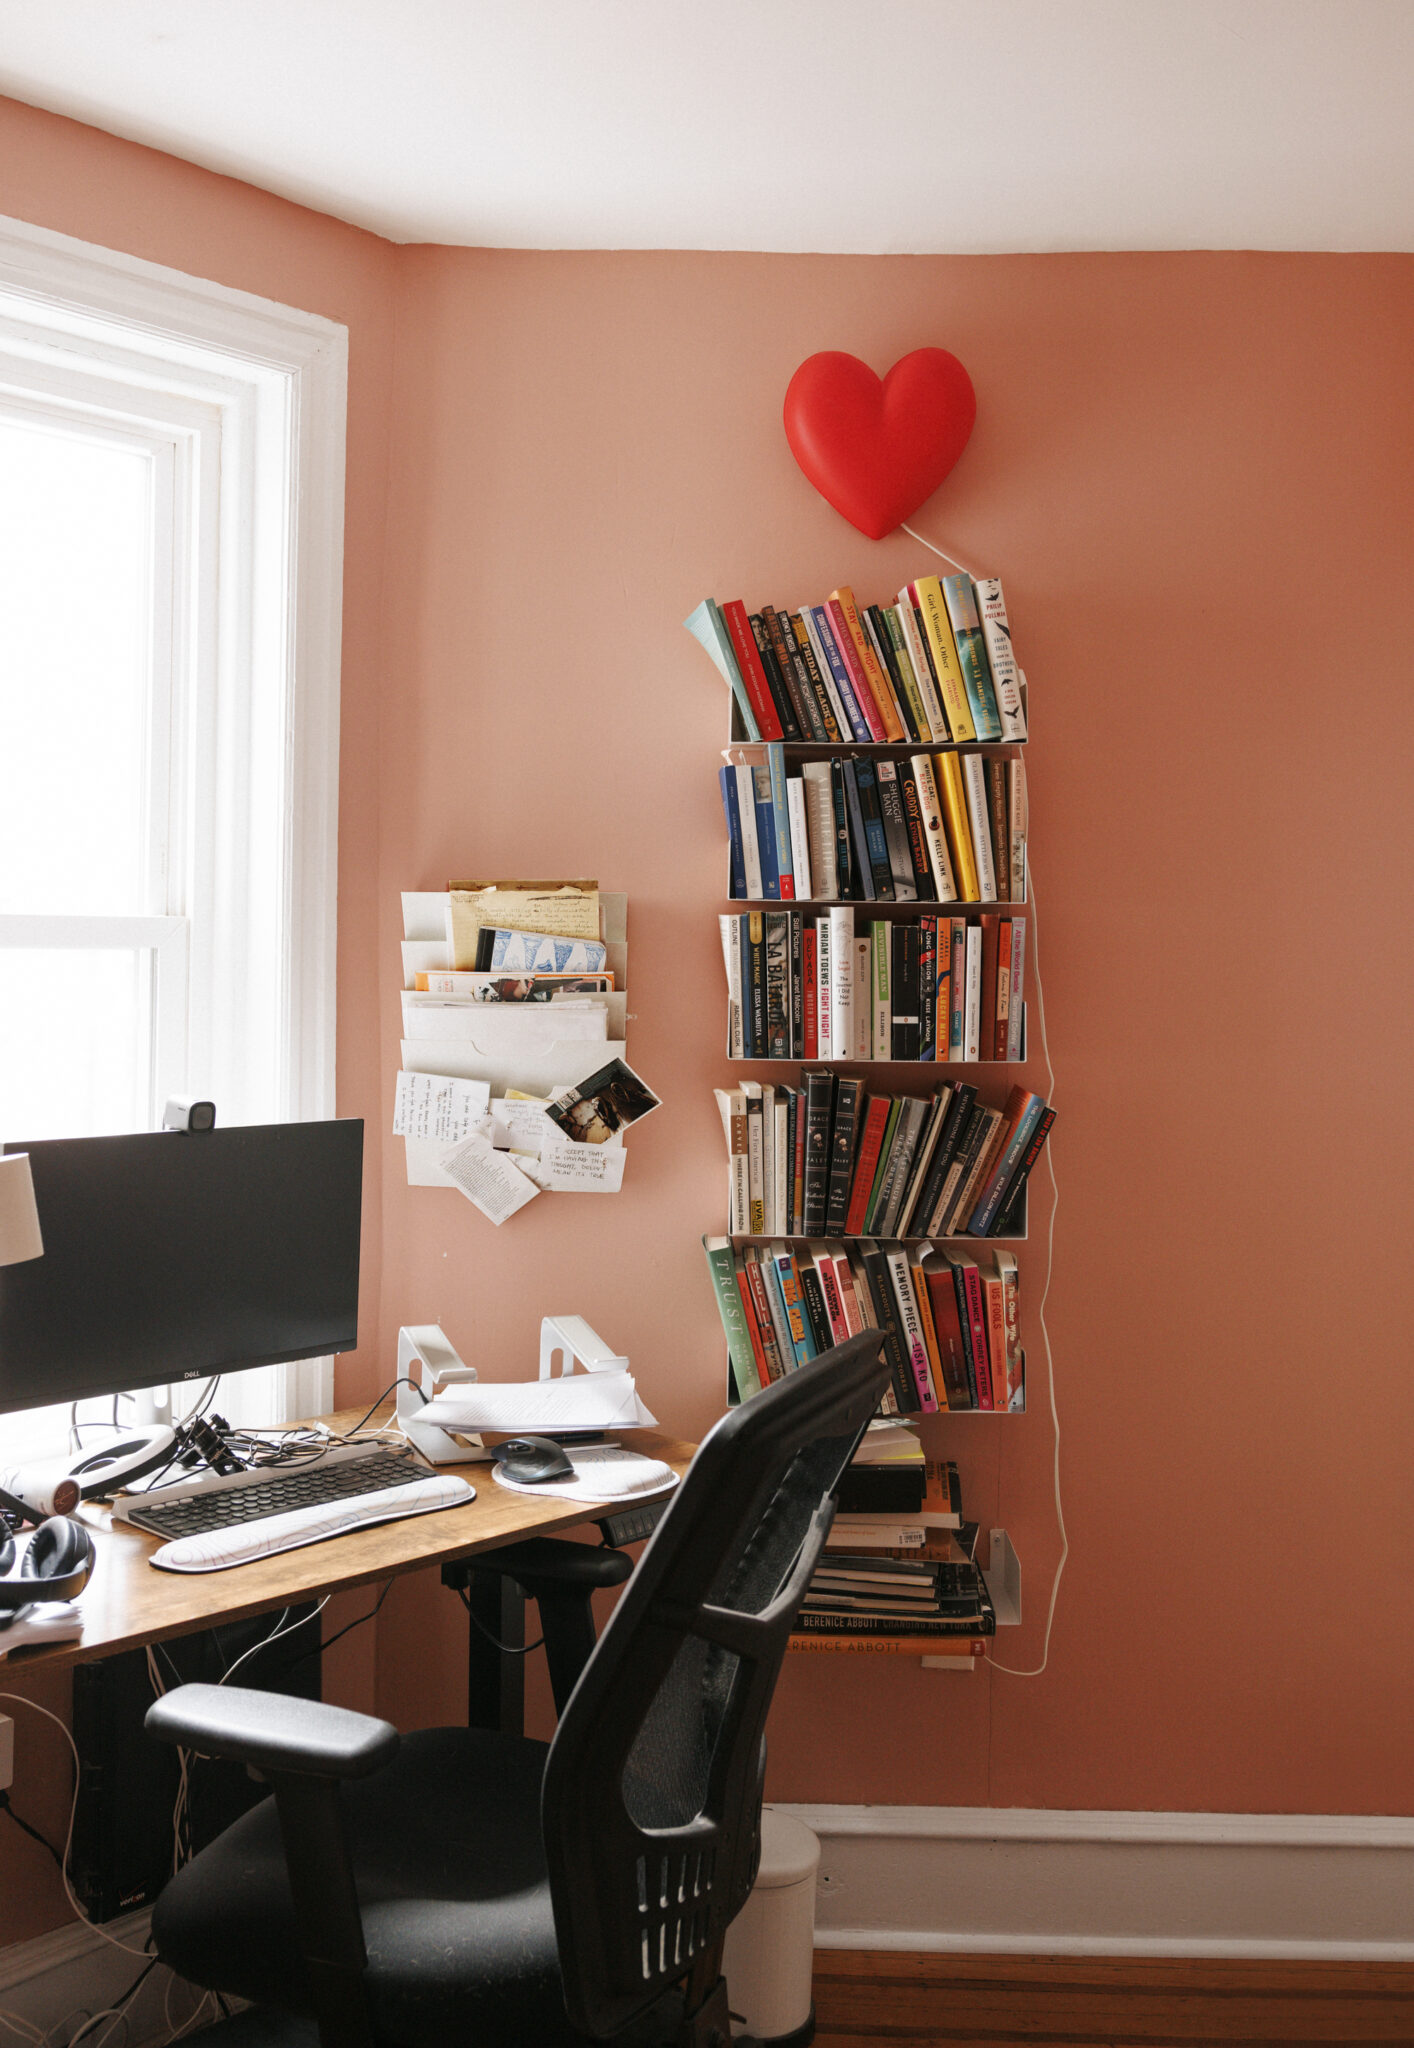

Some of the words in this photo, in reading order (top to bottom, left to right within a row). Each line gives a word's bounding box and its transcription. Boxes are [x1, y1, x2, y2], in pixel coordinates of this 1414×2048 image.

[926, 593, 937, 612] Girl,
[985, 611, 1006, 619] PULLMAN
[778, 611, 791, 633] BLACK
[930, 612, 944, 645] Woman,
[784, 632, 797, 652] LIGHT
[844, 604, 858, 625] STAY
[853, 630, 864, 646] AND
[862, 651, 877, 676] FIGHT
[938, 646, 950, 669] Other
[993, 660, 1014, 669] BROTHERS
[802, 642, 820, 684] FRIDAY
[816, 684, 832, 719] BLACK
[856, 672, 868, 695] Susan
[863, 694, 878, 722] Stinson
[949, 678, 962, 710] BERNARDINE
[914, 703, 924, 722] colwin
[817, 774, 828, 782] A
[919, 774, 928, 793] BLACK
[923, 763, 931, 783] WHITE
[928, 785, 936, 800] CAT,
[882, 794, 892, 816] BAIN
[889, 784, 902, 824] SHUGGIE
[904, 779, 920, 819] CRUDDY
[923, 795, 931, 810] DOG
[818, 788, 832, 839] LITTLE
[975, 800, 984, 828] WATKINS
[811, 813, 819, 865] YANAGIHARA
[909, 821, 918, 846] LYNDA
[914, 848, 925, 874] BARRY
[821, 842, 834, 872] LIFE
[979, 834, 989, 874] BATTLEBORN
[938, 860, 946, 877] LINK
[767, 942, 782, 958] LA
[819, 923, 828, 954] MIRIAM
[876, 929, 886, 972] INVISIBLE
[820, 958, 829, 985] TOEWS
[879, 972, 887, 992] MAN
[1012, 971, 1020, 992] Beside
[767, 964, 786, 1028] BÂTARDE
[820, 987, 829, 1011] FIGHT
[820, 1014, 829, 1038] NIGHT
[958, 1093, 968, 1113] NEVER
[1030, 1104, 1038, 1115] THE
[735, 1116, 743, 1153] CARVER
[906, 1128, 915, 1145] THE
[949, 1113, 962, 1139] ANYONE
[944, 1139, 953, 1152] BUT
[1007, 1143, 1020, 1164] WINDOW
[899, 1150, 910, 1171] LAST
[939, 1152, 949, 1166] YOU
[889, 1174, 904, 1210] SAMURAI
[995, 1175, 1005, 1190] KYLE
[986, 1190, 998, 1210] DILLON
[978, 1209, 990, 1228] HERTZ
[822, 1272, 829, 1284] OF
[892, 1262, 913, 1303] MEMORY
[968, 1274, 977, 1295] STAG
[717, 1259, 743, 1334] TRUST
[752, 1264, 770, 1326] HELL
[781, 1277, 799, 1306] BIG
[805, 1278, 815, 1306] RAINBOW
[824, 1286, 836, 1321] BABYLON
[827, 1275, 835, 1291] THE
[831, 1292, 840, 1316] TOWN
[876, 1273, 891, 1318] BLACKOUTS
[991, 1287, 1000, 1299] US
[902, 1305, 919, 1334] PIECE
[971, 1296, 980, 1322] DANCE
[991, 1302, 1002, 1329] FOOLS
[786, 1307, 806, 1345] GIRL
[766, 1329, 780, 1366] Kathryn
[911, 1342, 925, 1365] LISA
[975, 1333, 984, 1365] TORREY
[890, 1336, 900, 1361] JUSTIN
[899, 1363, 908, 1392] TORRES
[917, 1368, 928, 1382] KO
[978, 1366, 987, 1396] PETERS
[803, 1616, 844, 1628] BERENICE
[846, 1617, 877, 1628] ABBOTT
[927, 1621, 947, 1630] NEW
[949, 1621, 971, 1631] YORK
[786, 1639, 840, 1651] RENICE
[847, 1640, 901, 1653] ABBOTT
[120, 1892, 145, 1906] verizon
